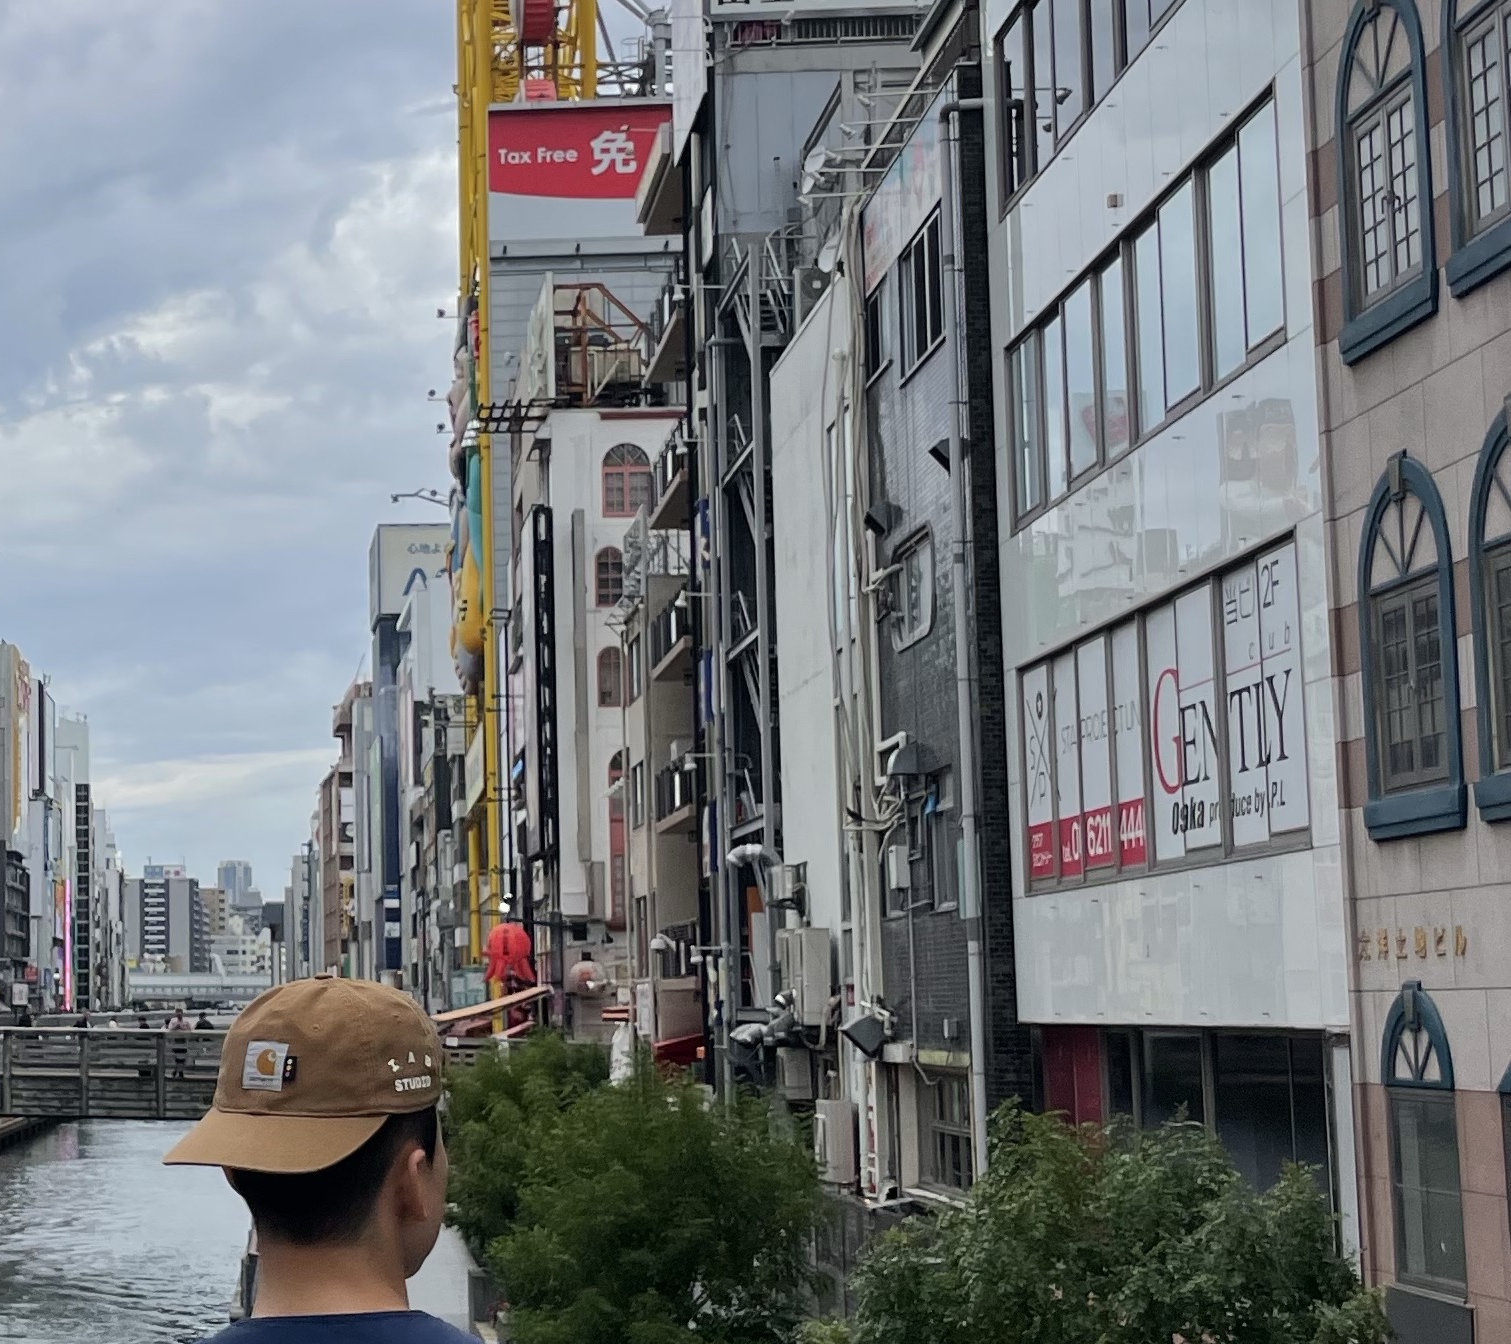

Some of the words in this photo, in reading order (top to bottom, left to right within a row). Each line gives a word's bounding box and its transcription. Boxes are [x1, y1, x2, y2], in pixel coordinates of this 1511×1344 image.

[498, 148, 531, 165] Tax
[537, 147, 578, 164] Free
[590, 130, 637, 176] 免
